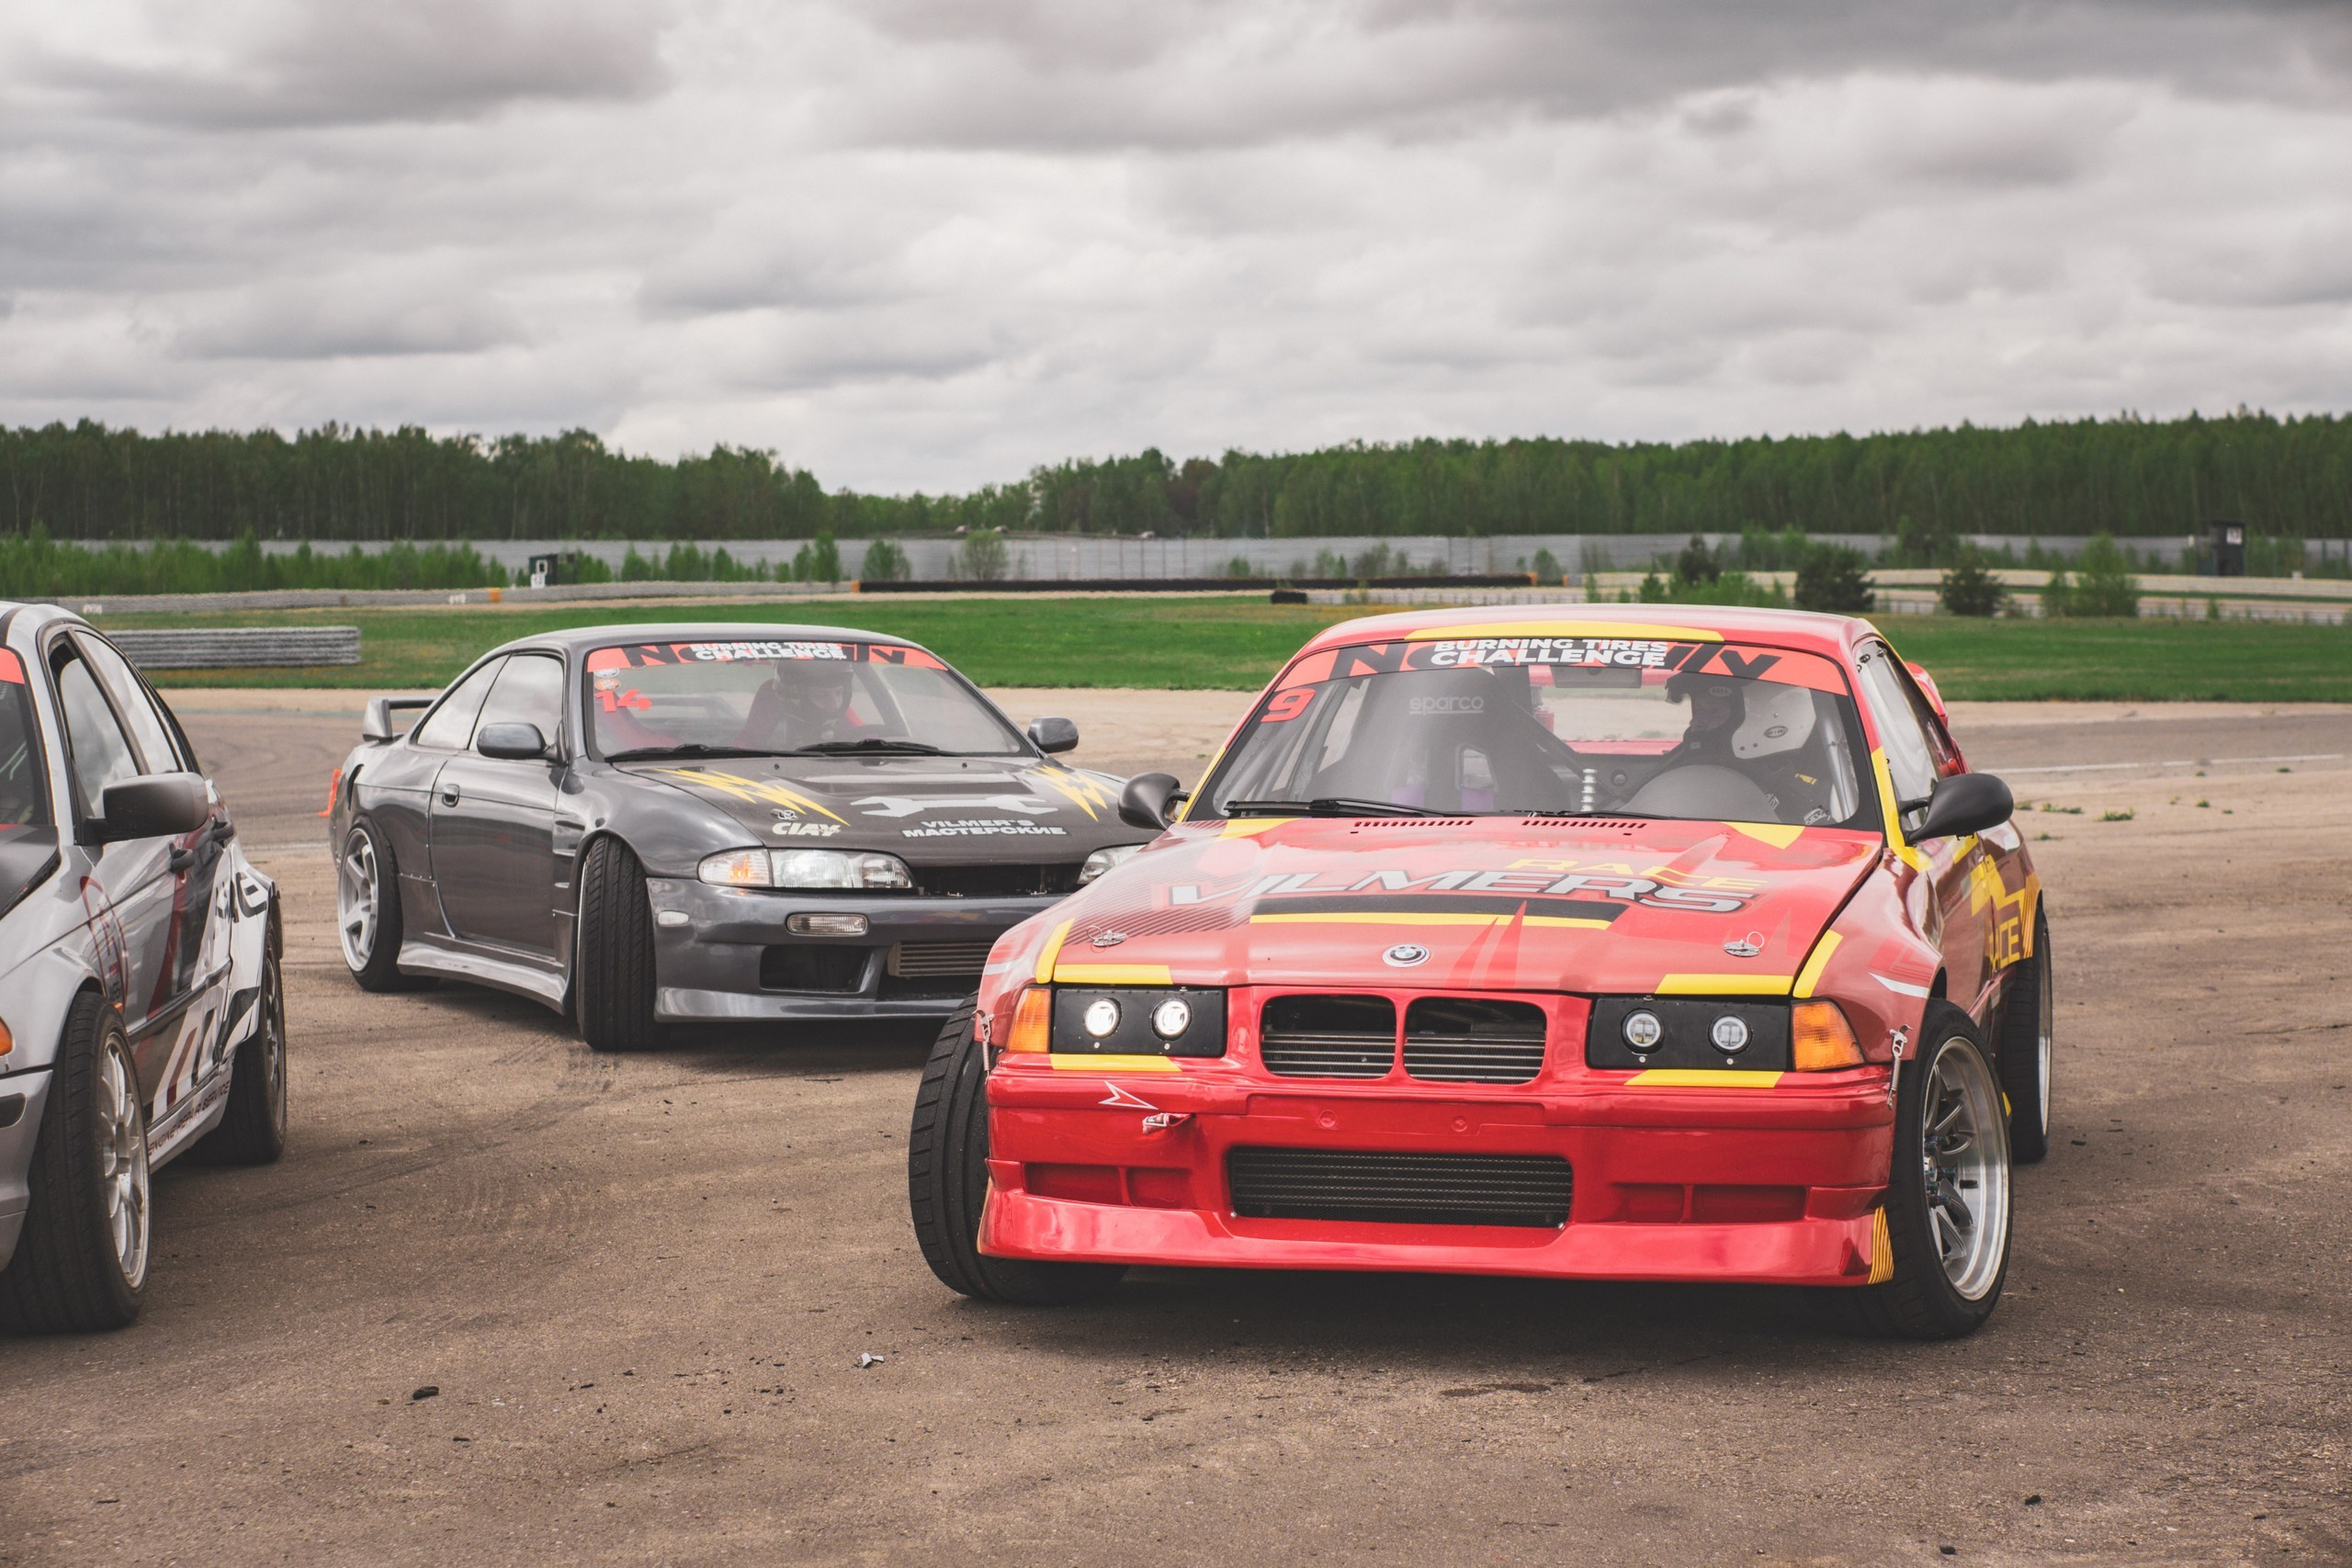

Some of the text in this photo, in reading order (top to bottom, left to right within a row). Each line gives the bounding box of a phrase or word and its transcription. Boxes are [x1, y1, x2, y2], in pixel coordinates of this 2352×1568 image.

[690, 641, 842, 652] BURNING TIRES
[1433, 637, 1668, 652] BURNING TIRES
[695, 649, 847, 660] CHALLENGE
[1430, 648, 1668, 667] CHALLENGE
[594, 688, 653, 713] 14
[1259, 687, 1317, 724] 9
[902, 827, 1068, 838] МАСТЕРСКИЕ
[920, 818, 1035, 829] VILMER'S
[1505, 858, 1770, 891] RACE
[1169, 869, 1759, 913] VILMERS
[202, 1080, 231, 1110] SERVICE
